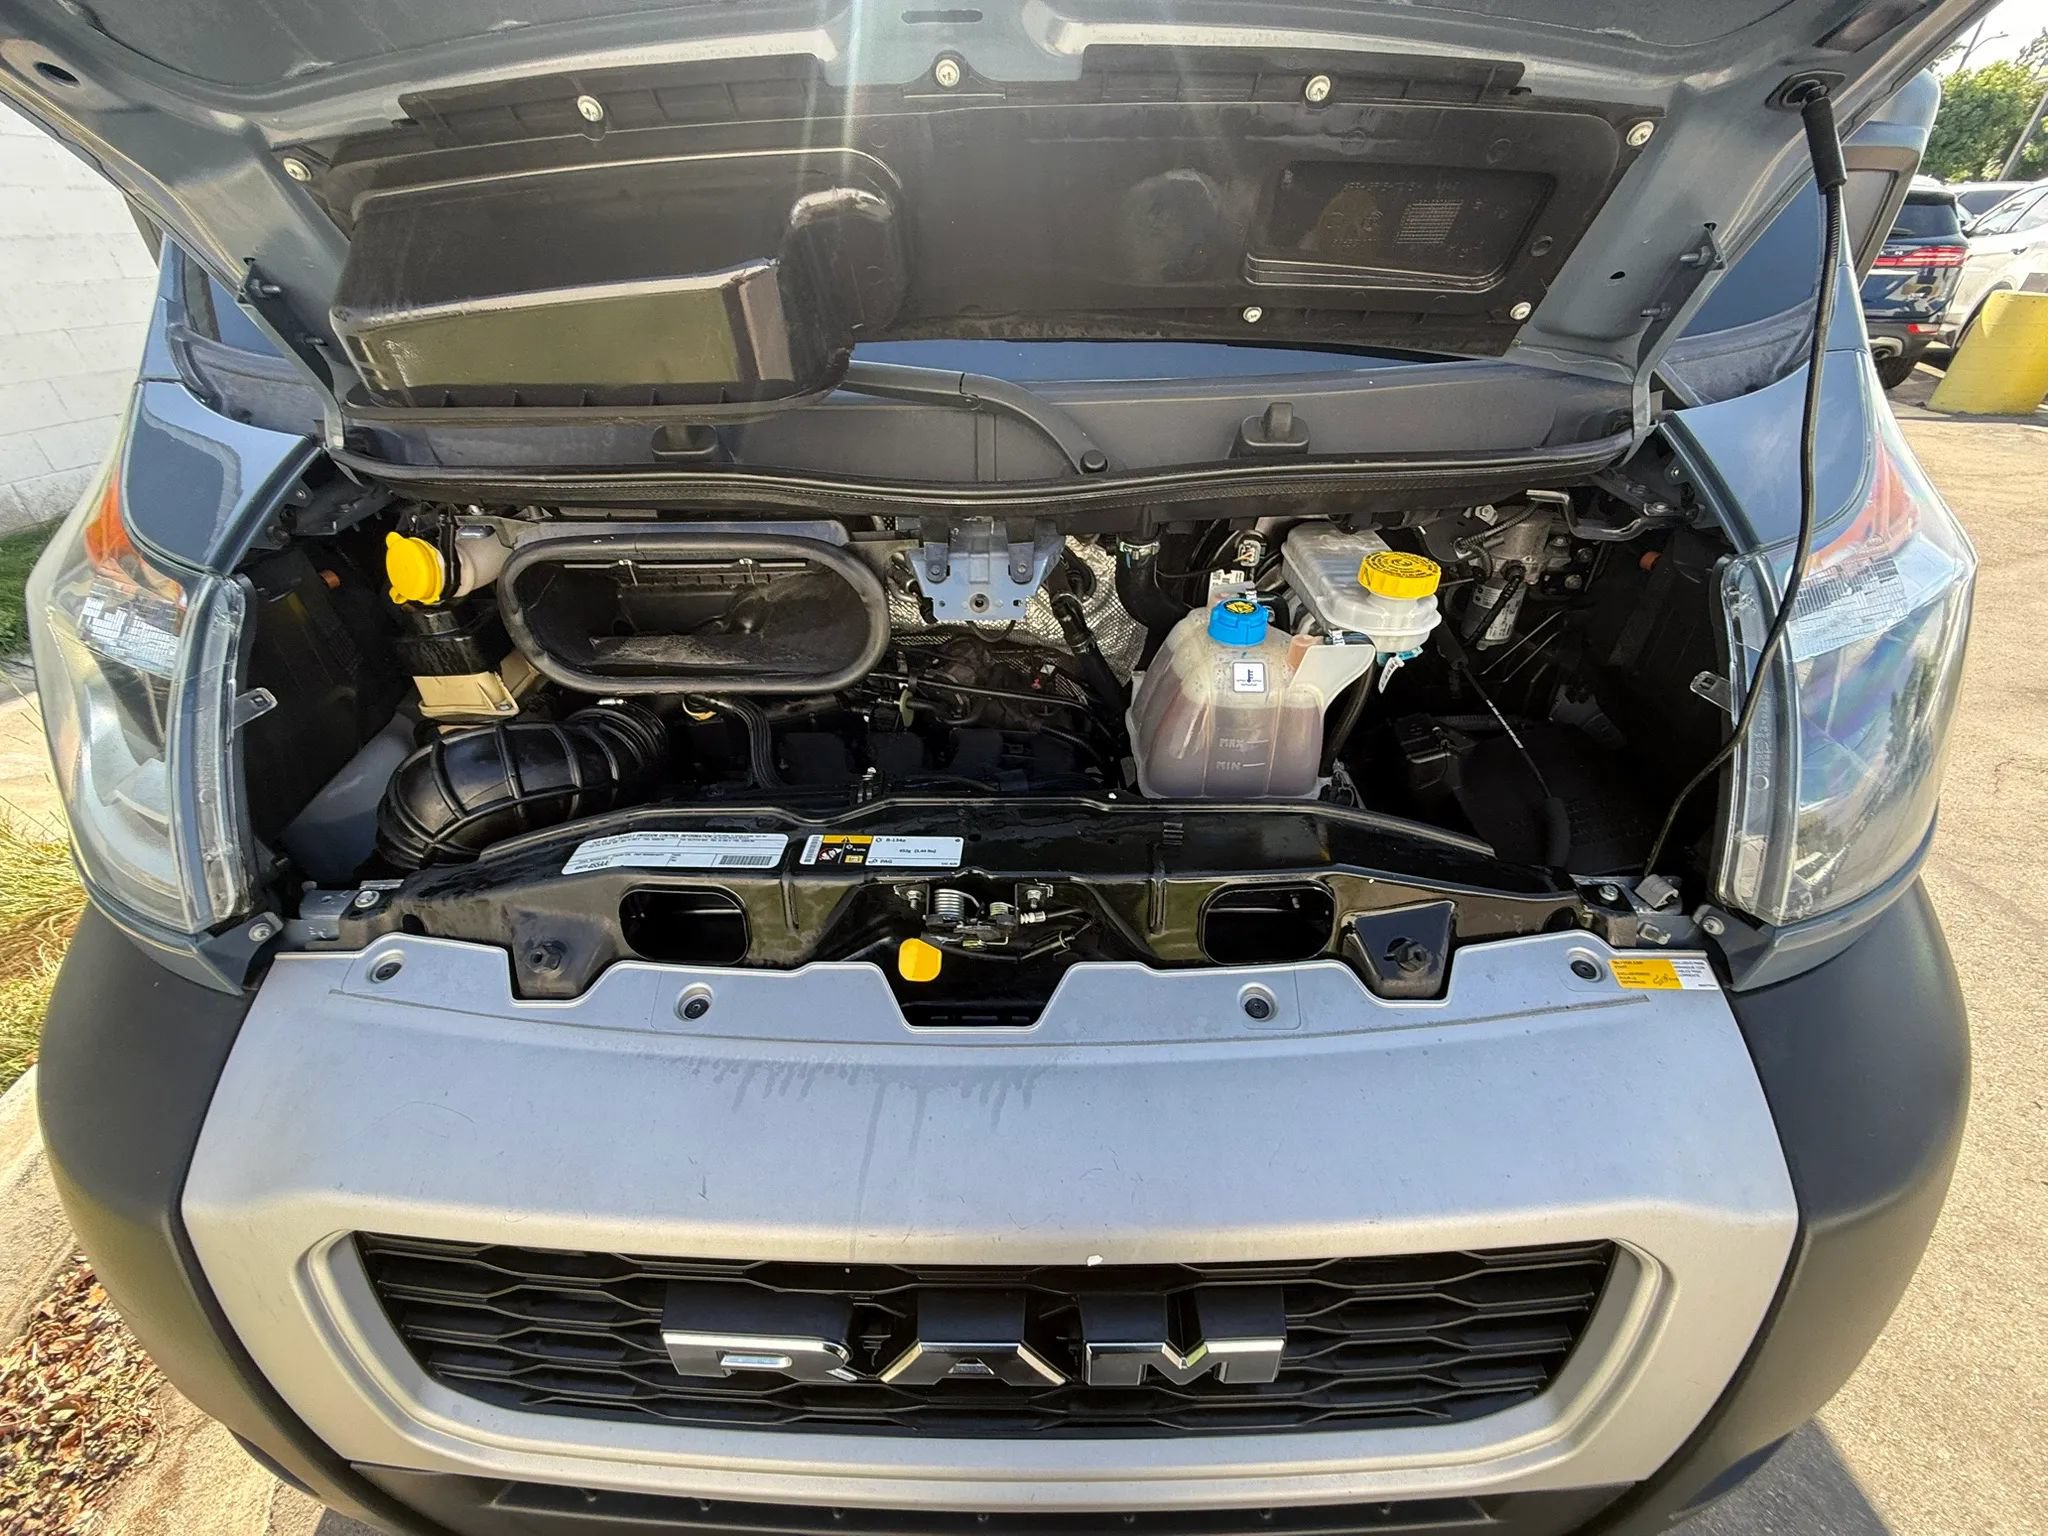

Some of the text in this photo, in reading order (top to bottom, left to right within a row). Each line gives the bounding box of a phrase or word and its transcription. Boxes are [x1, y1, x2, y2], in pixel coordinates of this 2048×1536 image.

[1219, 737, 1245, 748] MAX
[1216, 761, 1241, 770] MIN
[660, 1327, 1288, 1387] RAM
